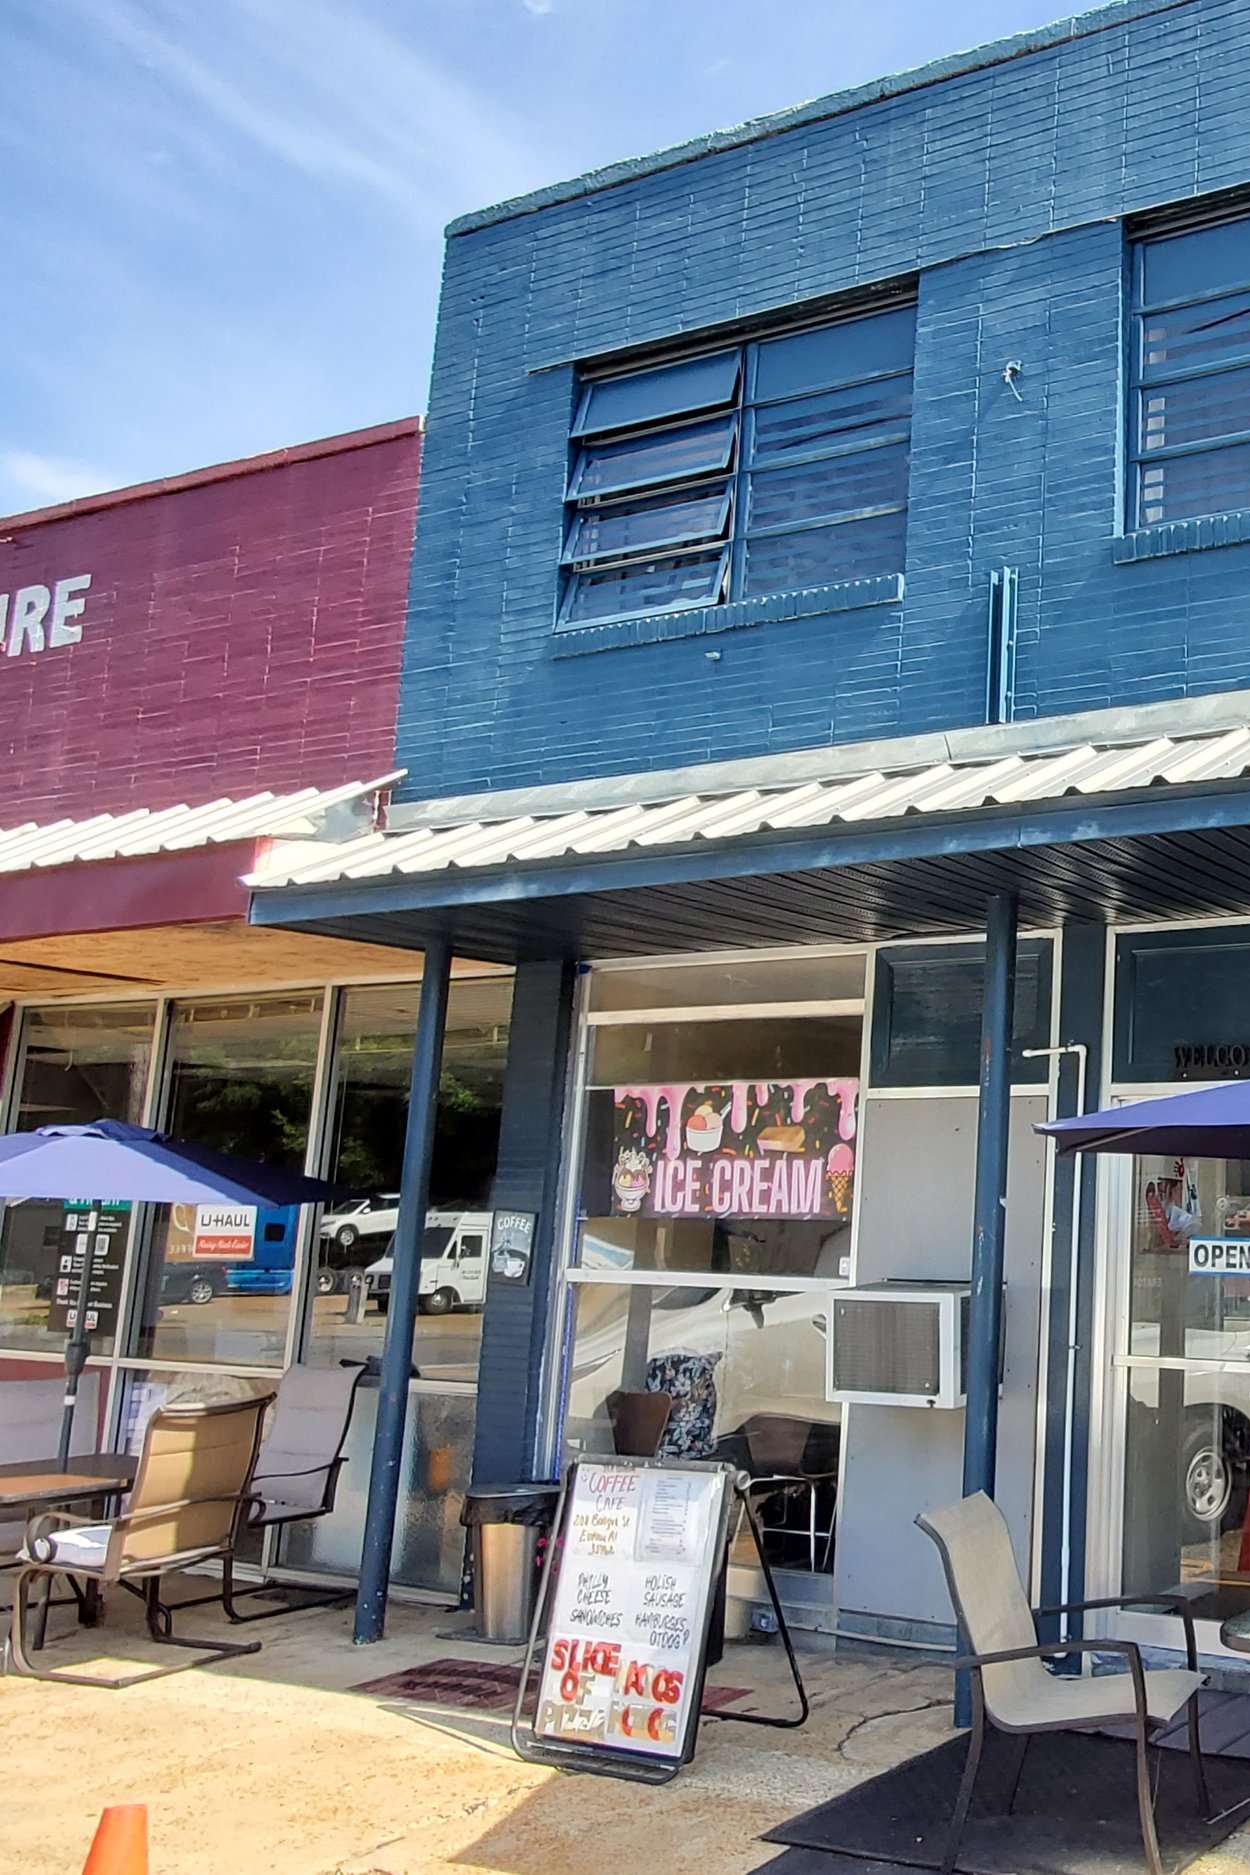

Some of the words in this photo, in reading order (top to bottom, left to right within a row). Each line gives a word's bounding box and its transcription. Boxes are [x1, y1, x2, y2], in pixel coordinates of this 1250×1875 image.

[654, 1158, 702, 1213] ICE
[712, 1158, 824, 1214] CREAM
[497, 1215, 532, 1235] COFFEE
[589, 1472, 640, 1493] COFFEE
[596, 1494, 625, 1512] CAFE
[577, 1589, 611, 1605] CHEESE
[643, 1591, 686, 1608] SAUSAGE
[570, 1608, 623, 1627] SANDWICHES
[551, 1639, 622, 1677] SLICE
[560, 1668, 596, 1705] OF
